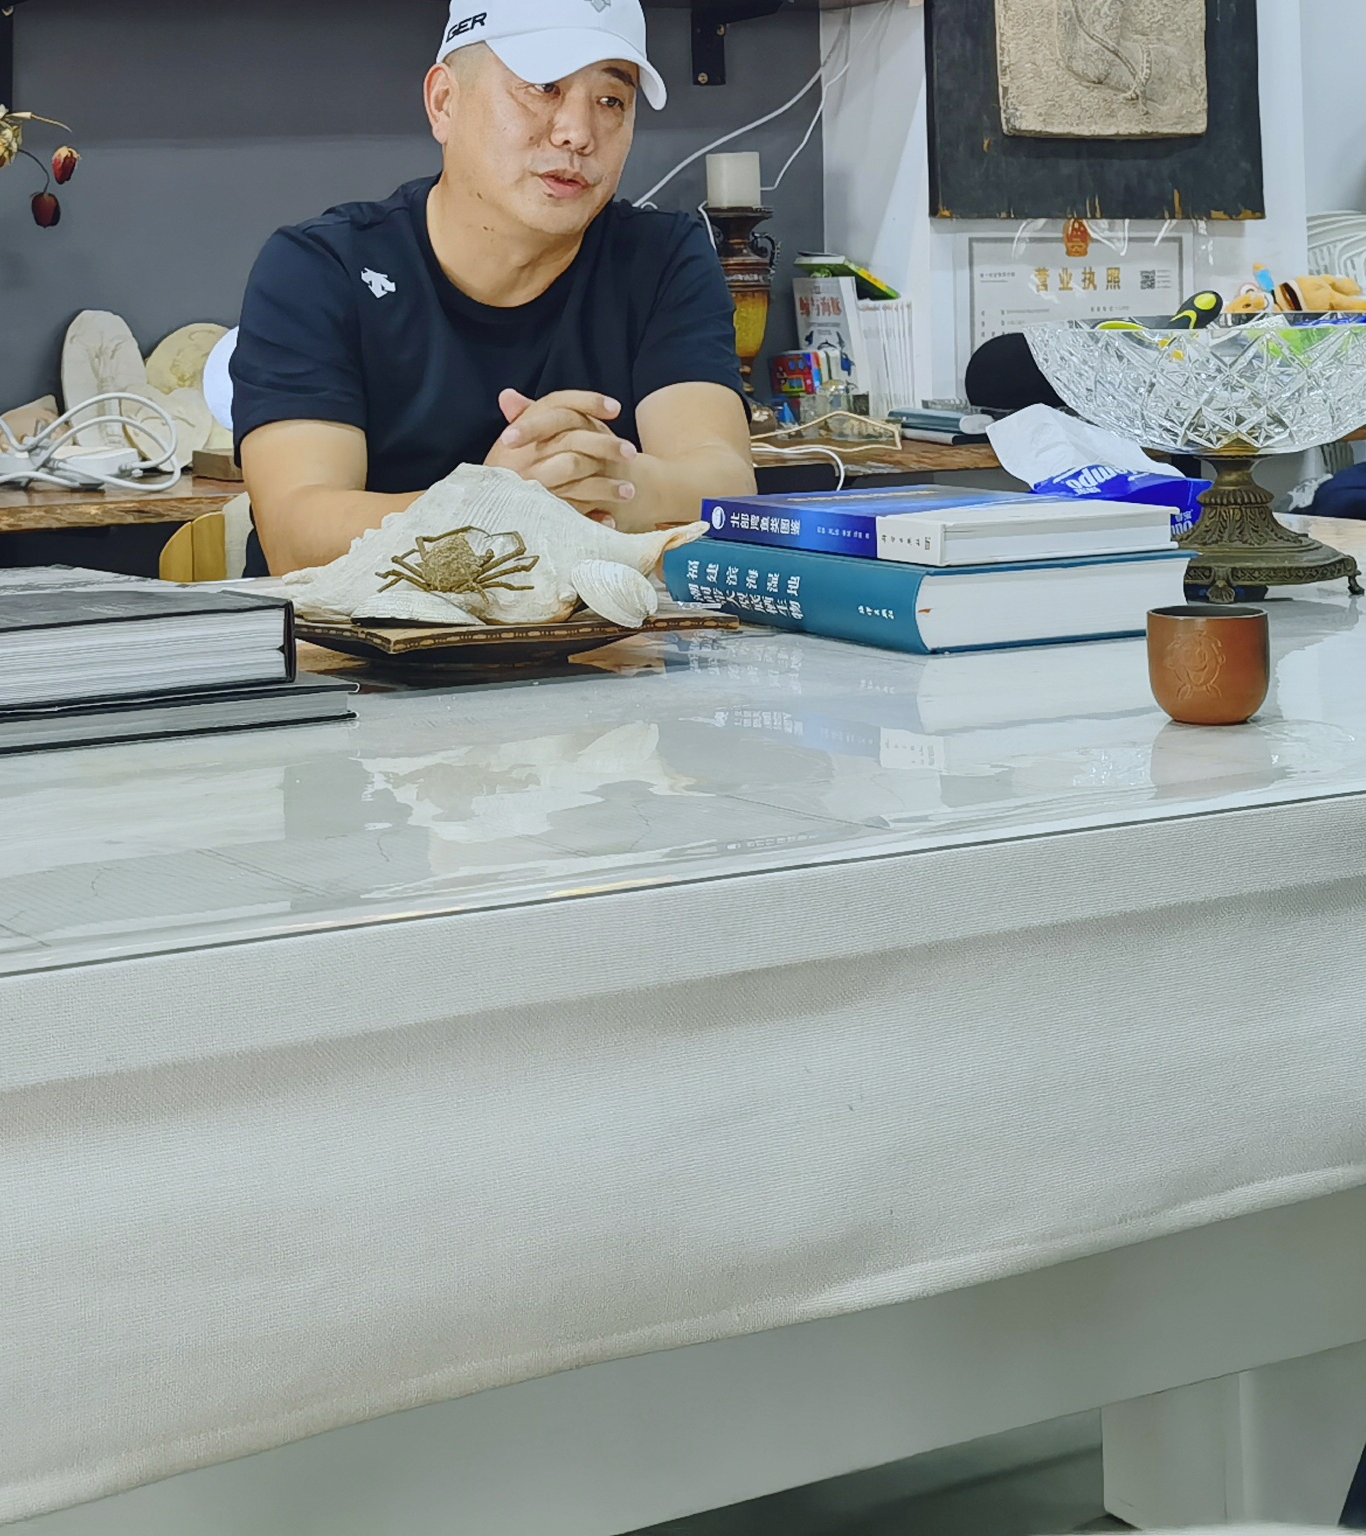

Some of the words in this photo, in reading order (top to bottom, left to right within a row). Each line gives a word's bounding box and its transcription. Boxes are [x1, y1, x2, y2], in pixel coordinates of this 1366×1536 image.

[1036, 267, 1121, 293] 营业执照
[730, 512, 801, 536] 北部湾鱼类图鉴
[686, 560, 802, 597] 福建滨海湿地
